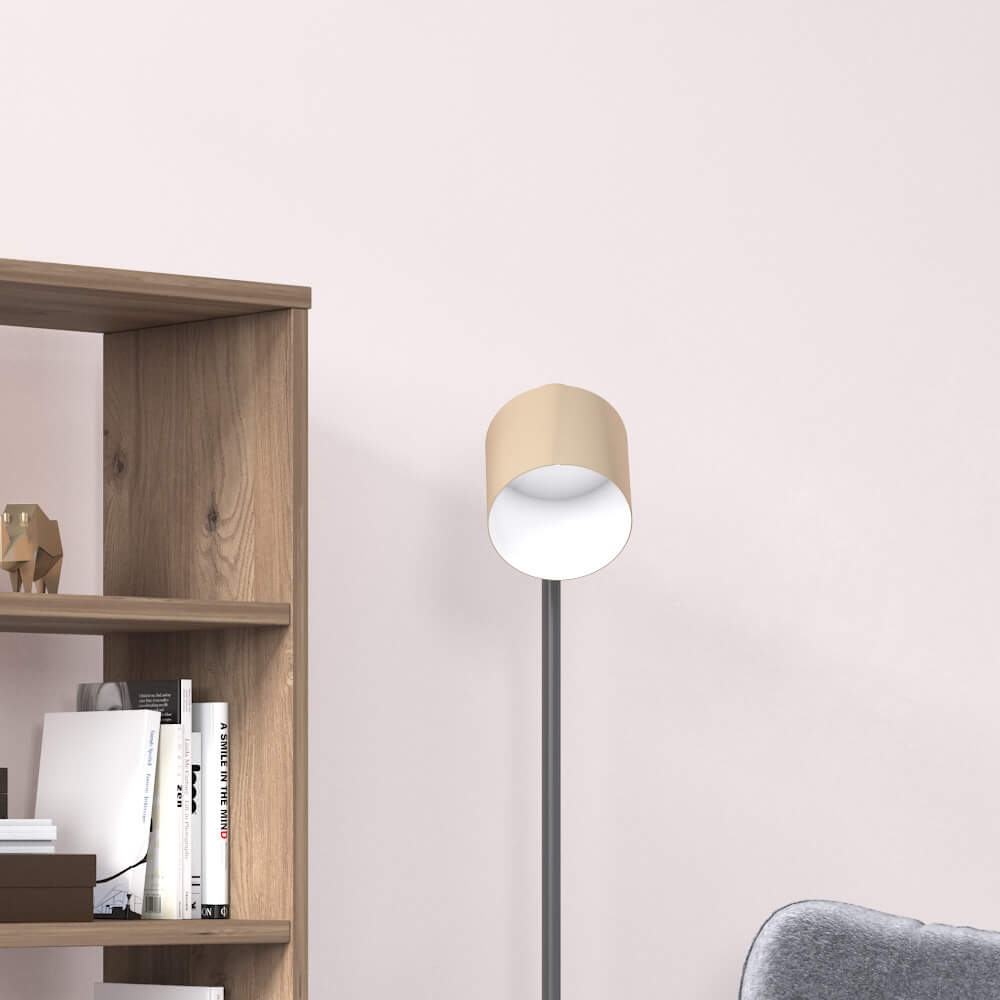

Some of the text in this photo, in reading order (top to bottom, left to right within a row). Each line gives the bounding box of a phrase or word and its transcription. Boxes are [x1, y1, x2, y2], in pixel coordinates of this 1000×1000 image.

[220, 722, 228, 839] A SMILE IN THE MIND
